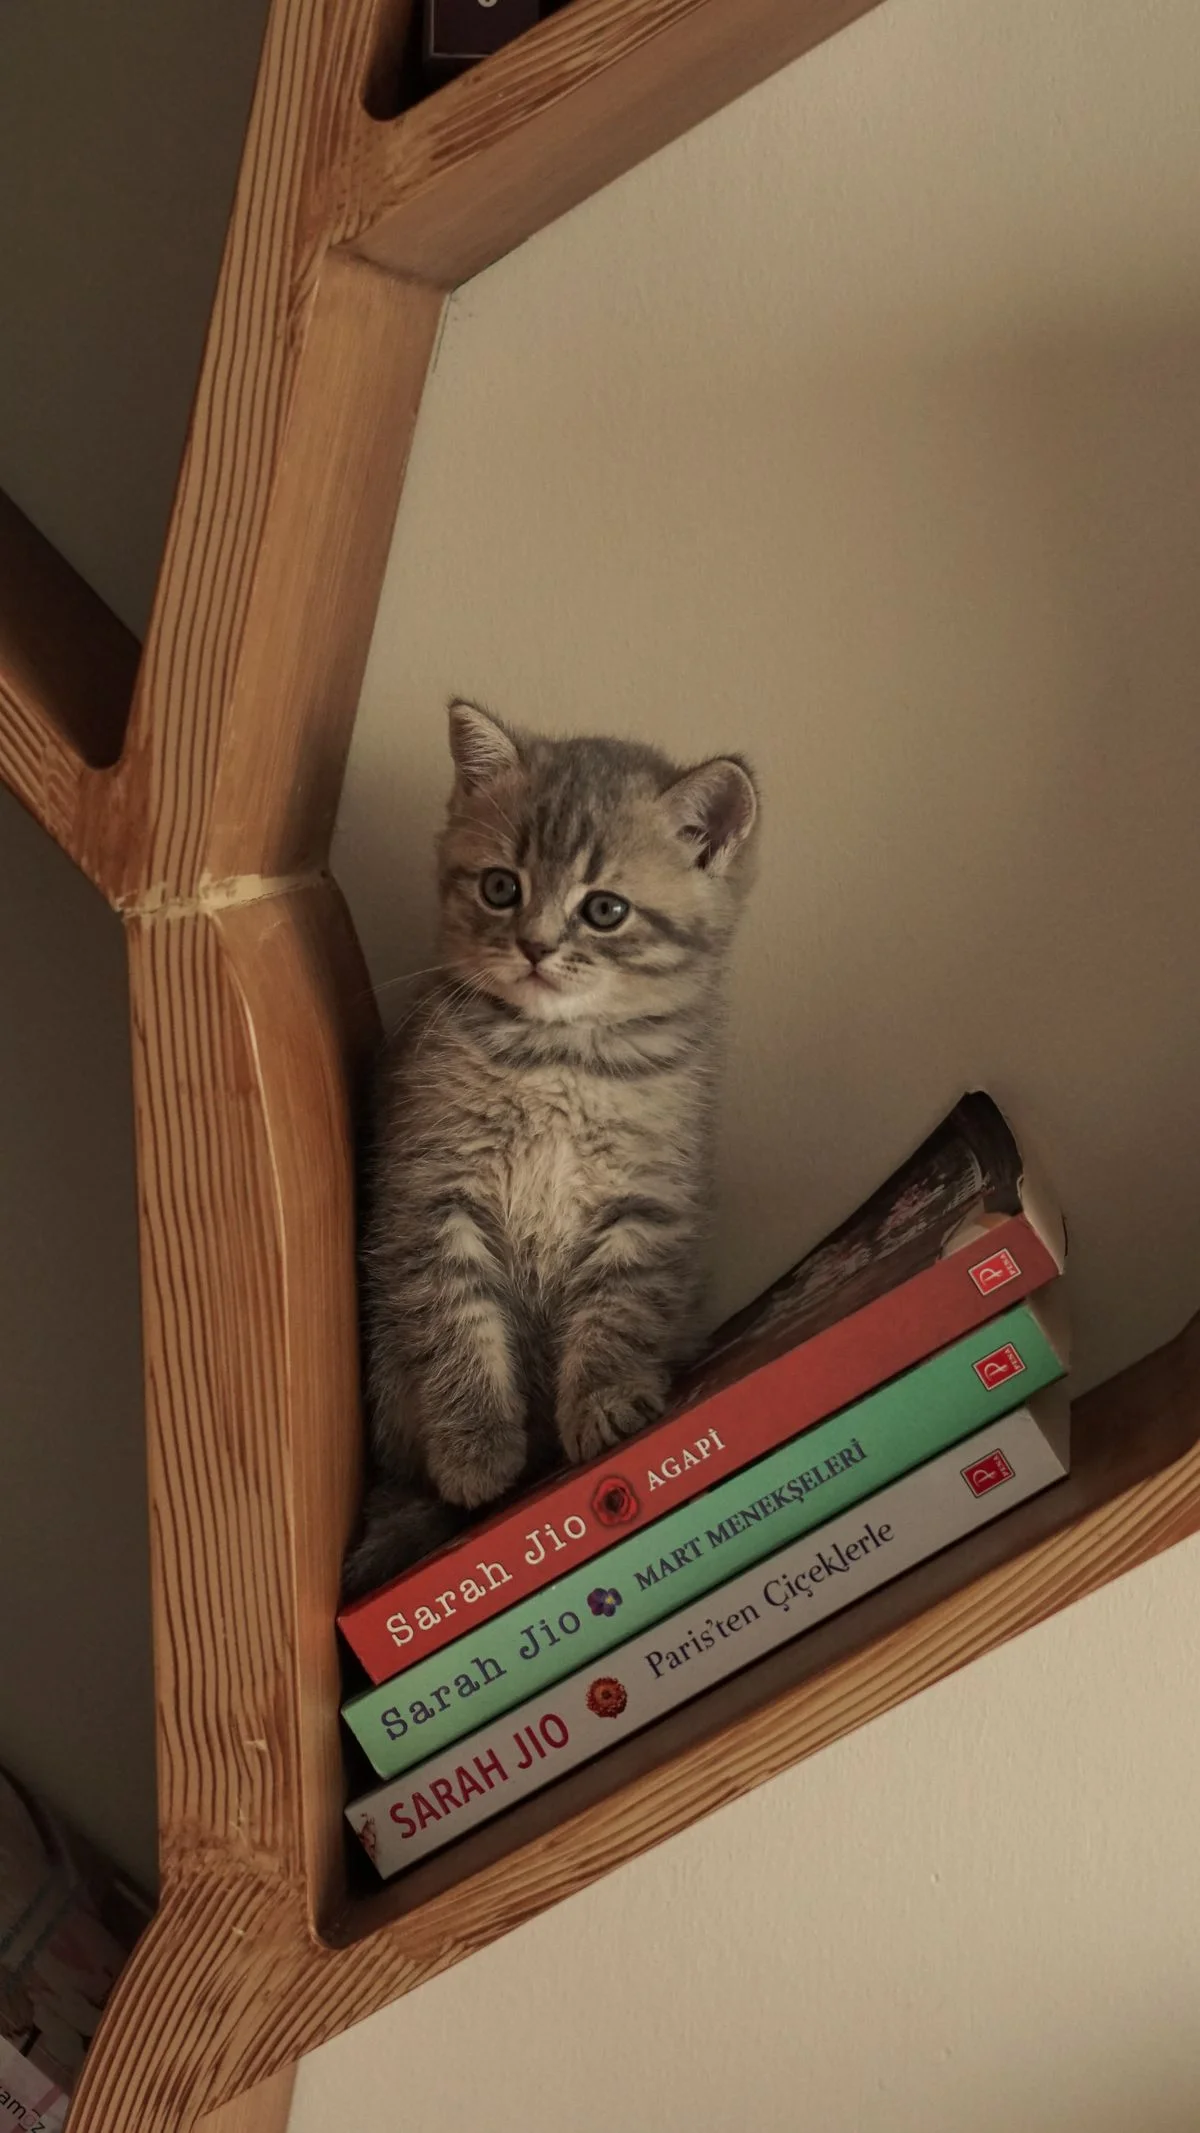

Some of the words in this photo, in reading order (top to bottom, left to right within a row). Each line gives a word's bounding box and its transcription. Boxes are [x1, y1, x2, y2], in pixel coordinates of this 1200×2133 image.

[633, 1537, 704, 1591] MART
[704, 1438, 868, 1549] MENEKŞELERİ
[646, 1428, 726, 1492] AGAPİ
[386, 1561, 513, 1647] Sarah
[524, 1515, 586, 1565] Jio
[644, 1602, 760, 1680] Paris'ten
[763, 1522, 895, 1612] Çiçeklerle
[381, 1656, 507, 1741] Sarah
[519, 1611, 581, 1660] Jio
[389, 1748, 509, 1839] SARAH
[513, 1713, 569, 1770] JIO
